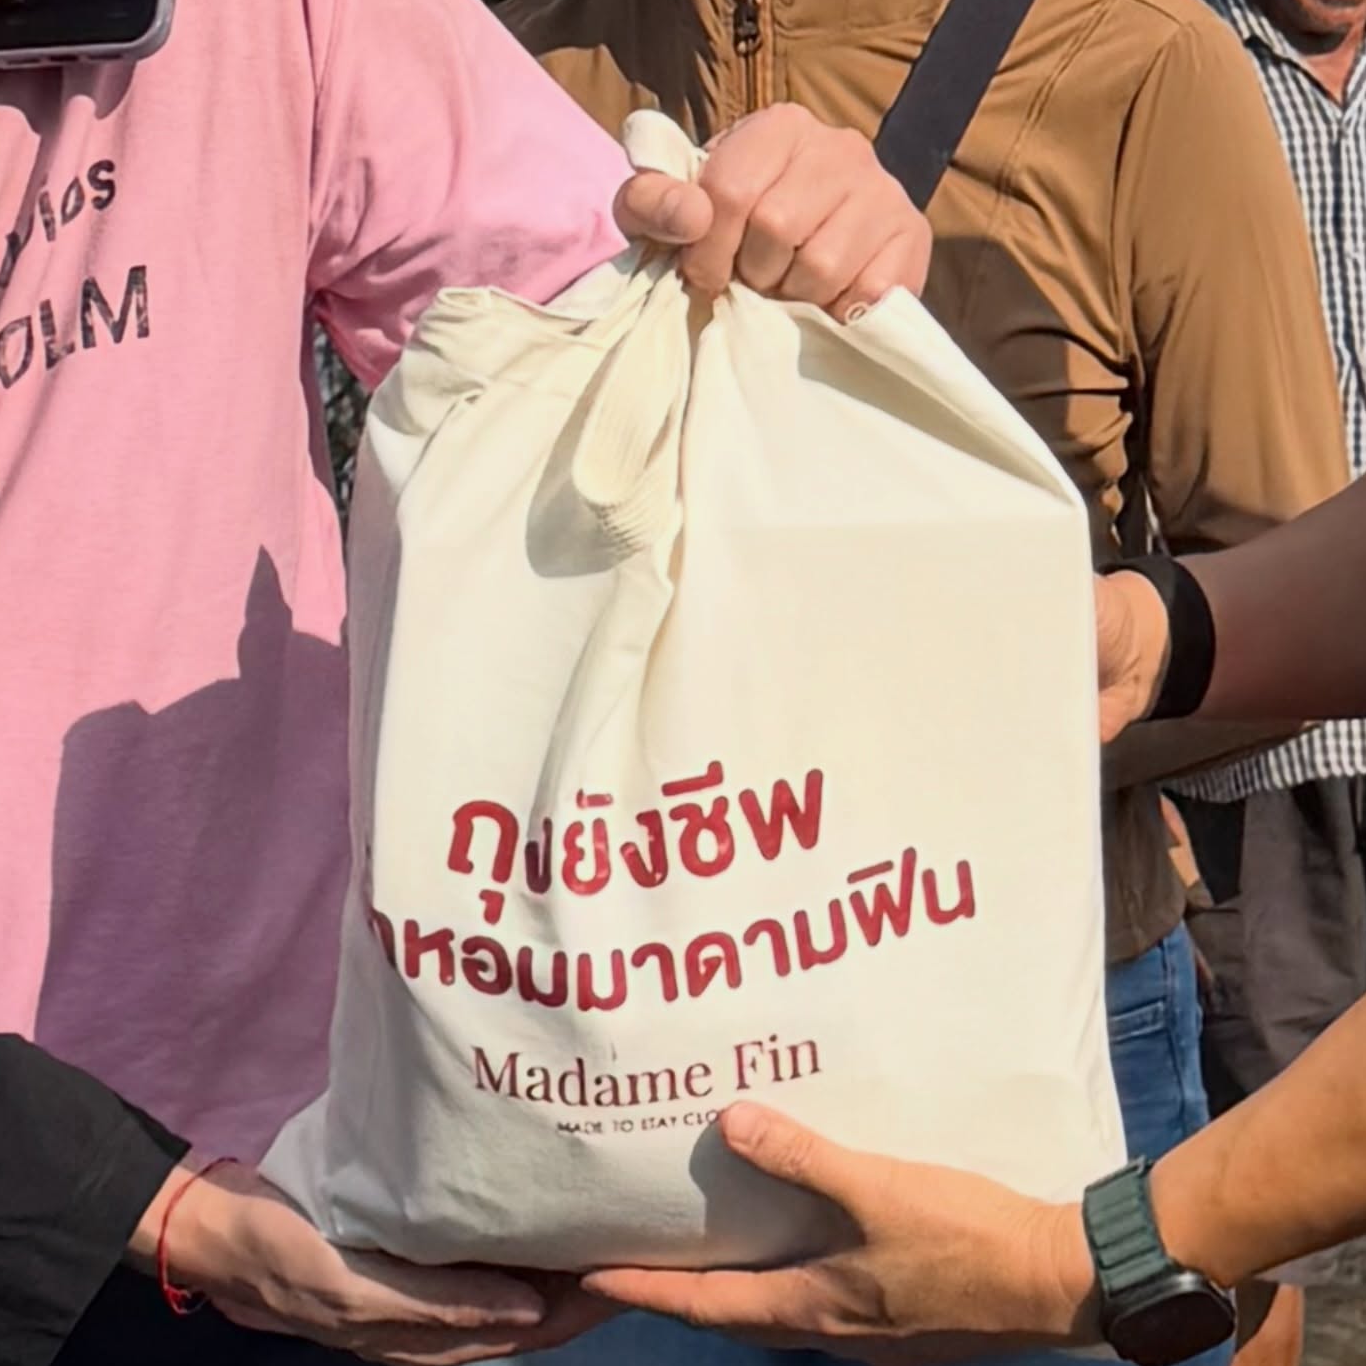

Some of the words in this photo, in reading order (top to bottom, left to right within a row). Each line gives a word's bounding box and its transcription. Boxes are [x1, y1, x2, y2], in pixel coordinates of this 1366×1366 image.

[471, 1045, 714, 1109] Madame
[733, 1034, 824, 1092] Fin
[683, 1109, 721, 1126] CLO
